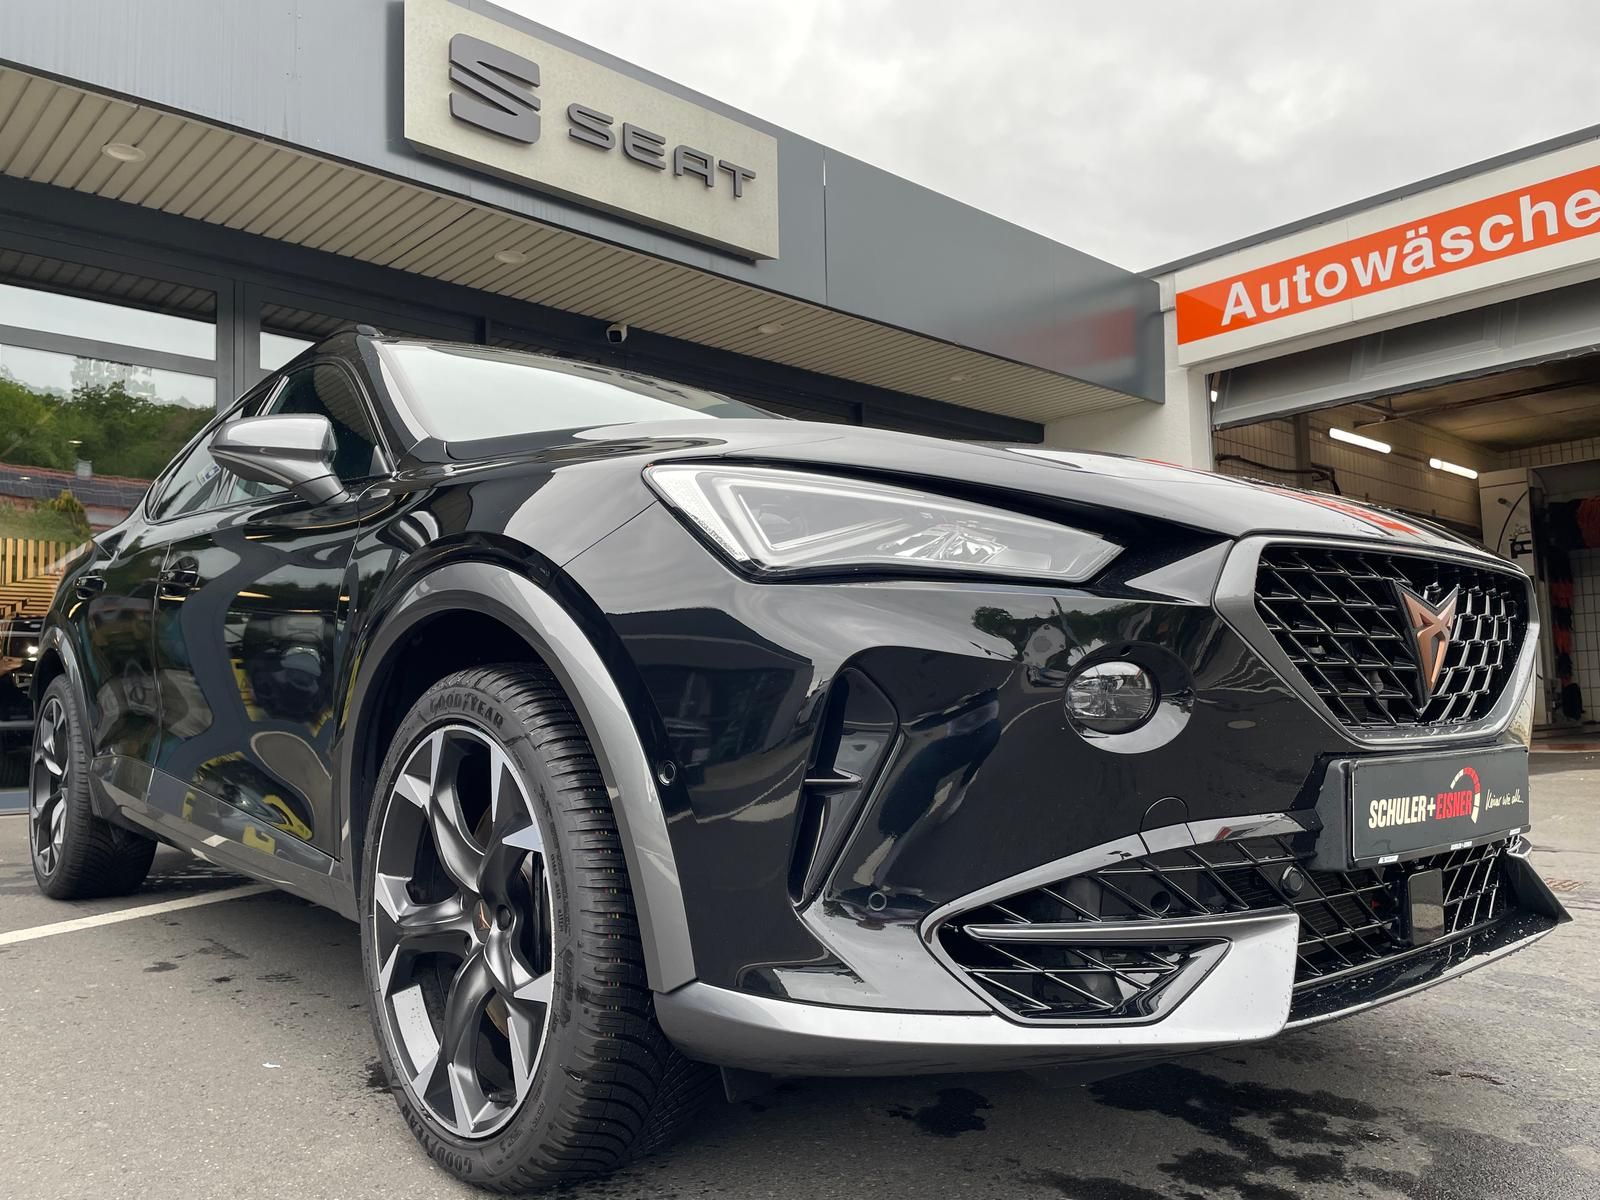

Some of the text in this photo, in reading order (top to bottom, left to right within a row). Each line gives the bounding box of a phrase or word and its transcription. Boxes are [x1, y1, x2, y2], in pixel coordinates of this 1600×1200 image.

[567, 102, 756, 199] SEAT
[1221, 188, 1600, 326] Autowäsche
[430, 692, 504, 730] GOODYEAR
